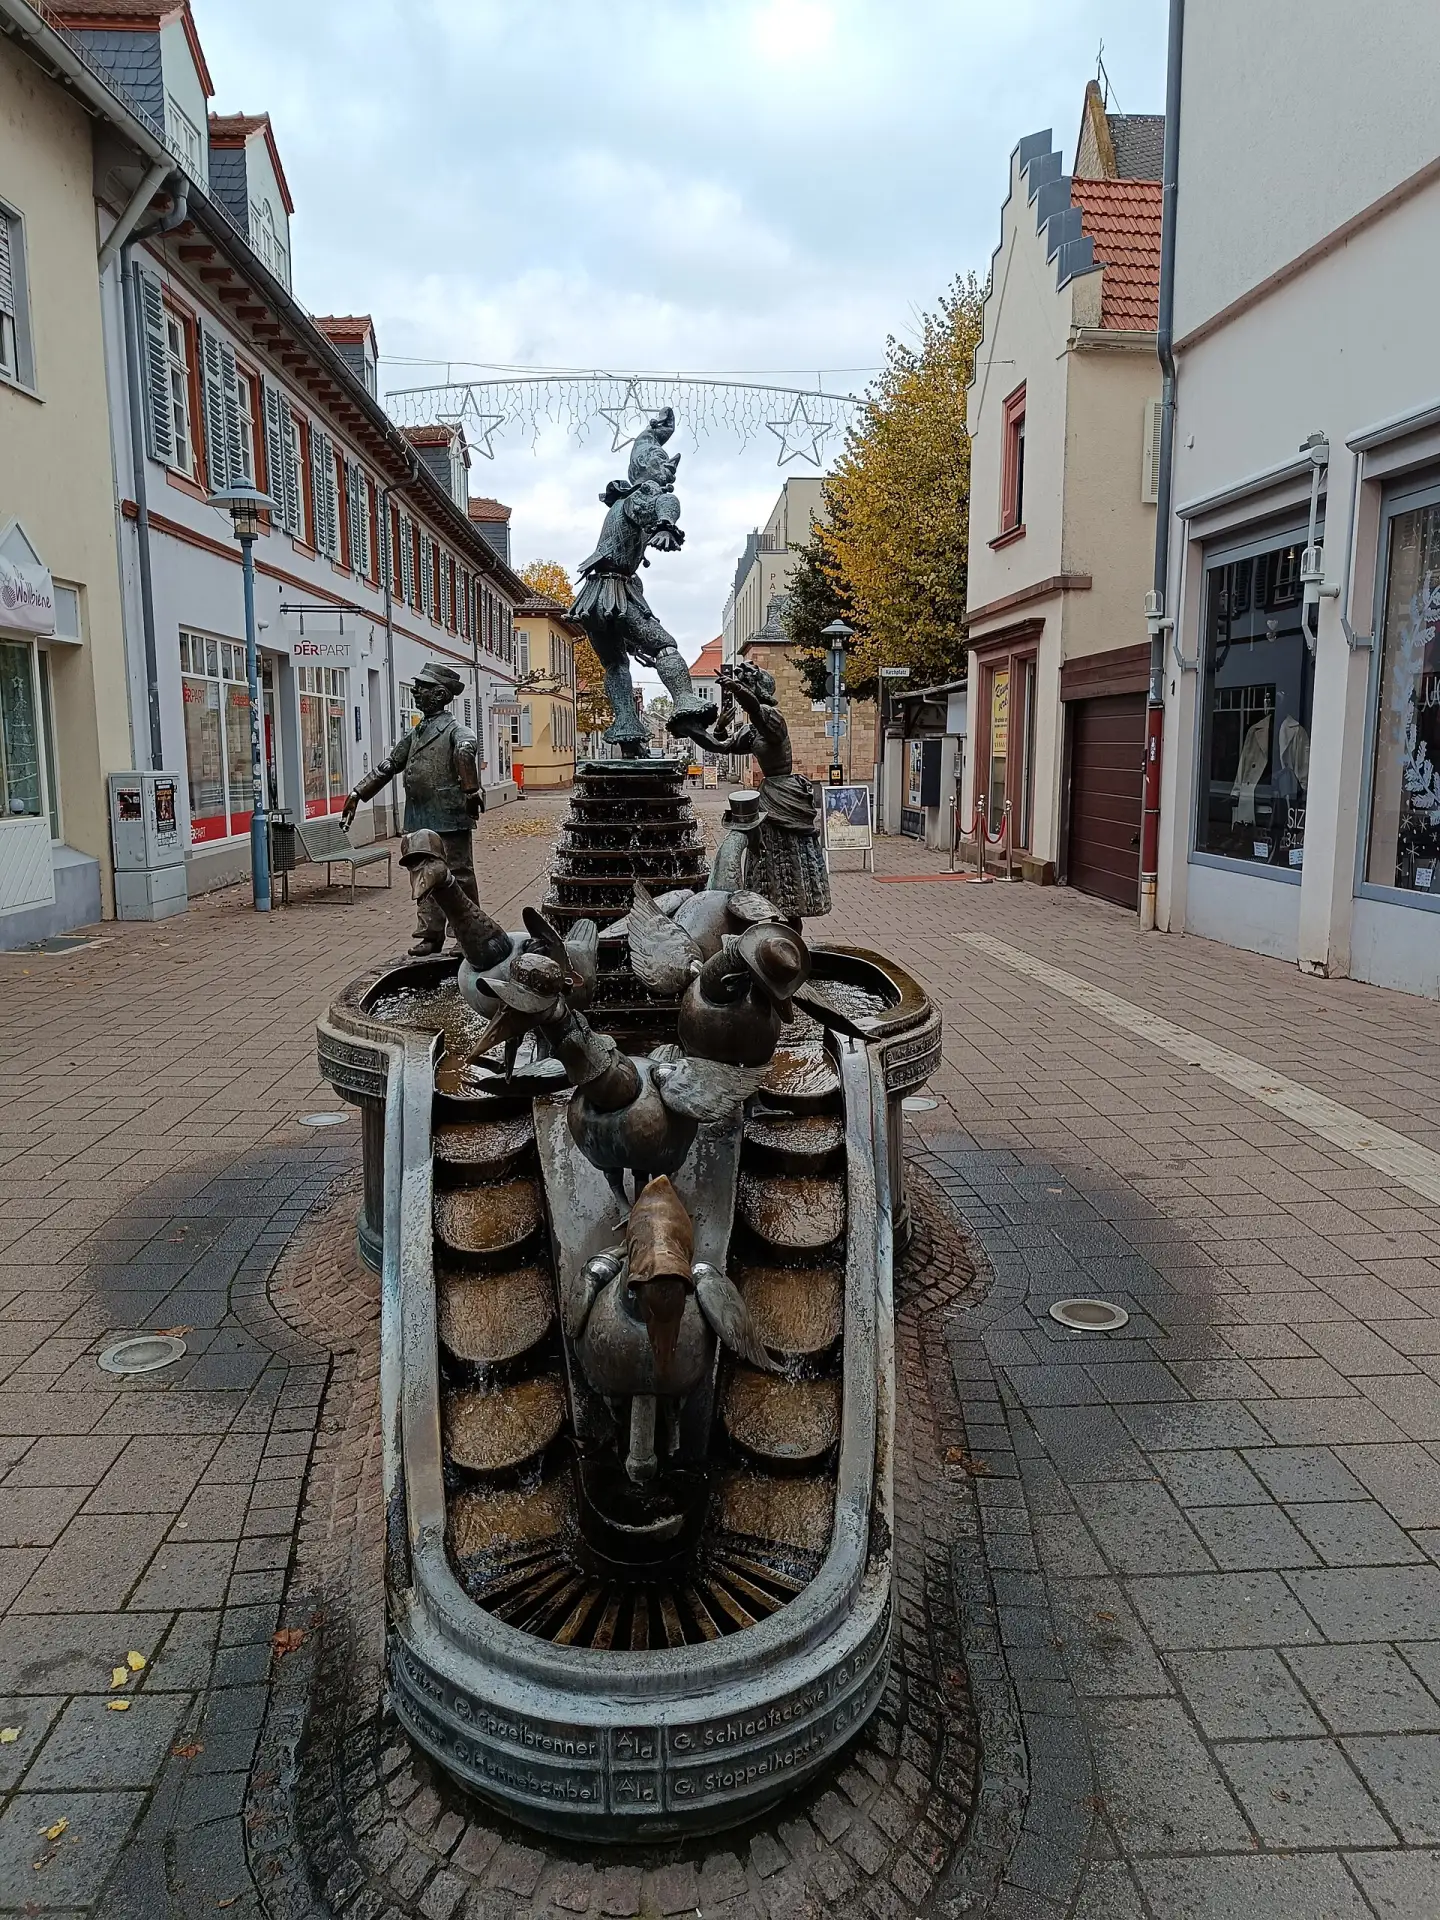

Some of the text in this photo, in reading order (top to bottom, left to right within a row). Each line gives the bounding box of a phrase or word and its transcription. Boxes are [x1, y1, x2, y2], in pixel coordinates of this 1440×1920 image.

[14, 579, 51, 608] Wollbiene
[293, 641, 351, 656] DERPART
[1170, 680, 1176, 696] 1
